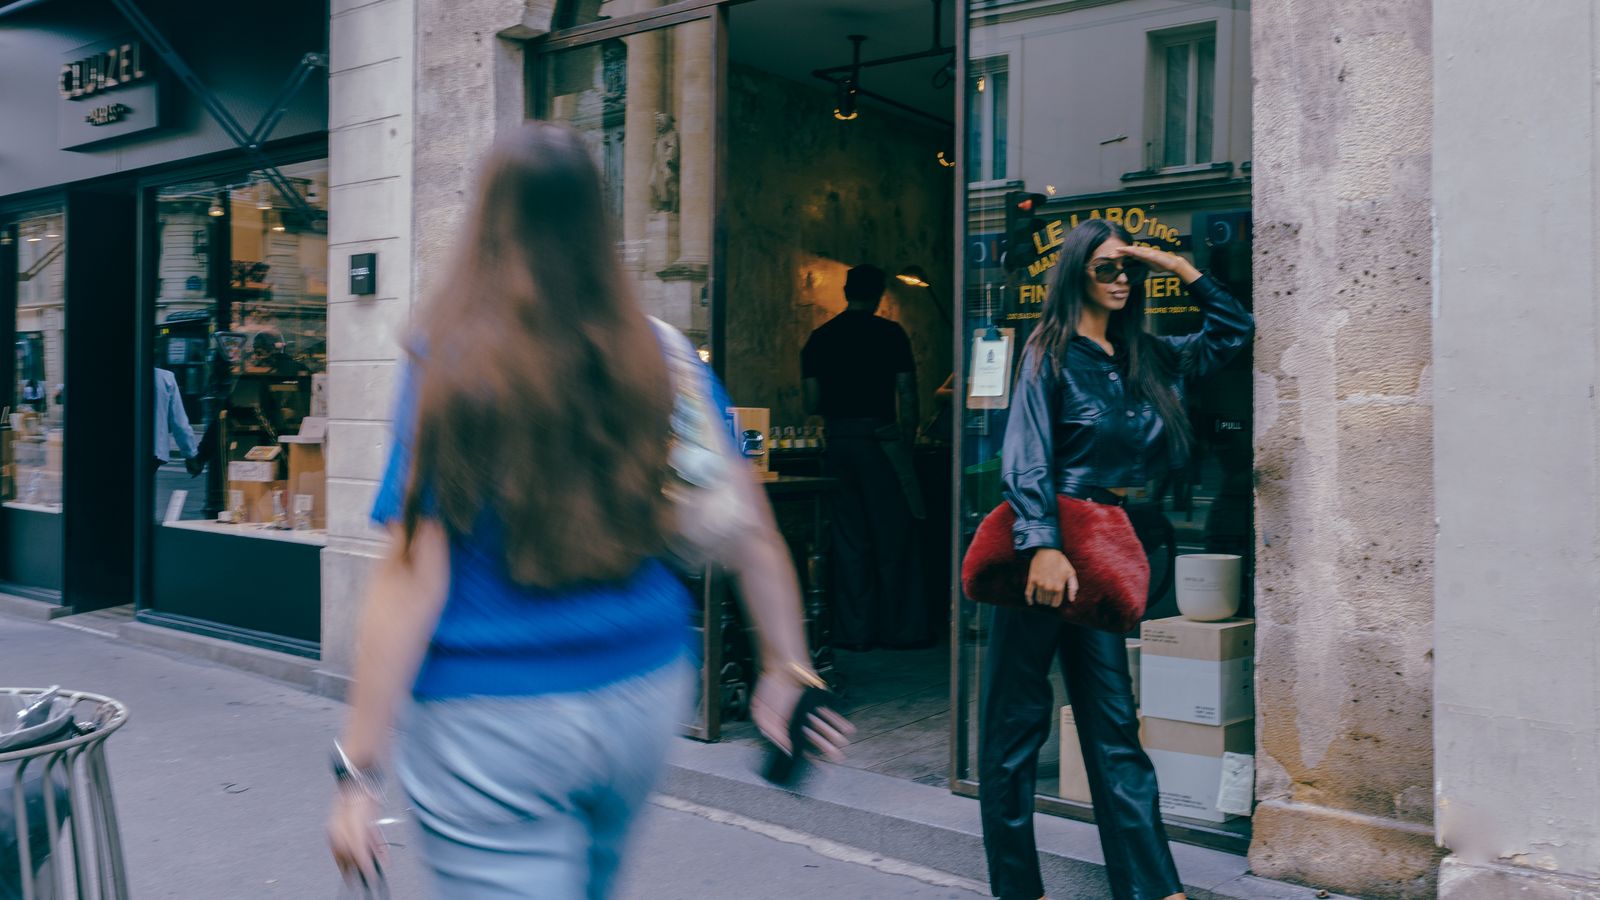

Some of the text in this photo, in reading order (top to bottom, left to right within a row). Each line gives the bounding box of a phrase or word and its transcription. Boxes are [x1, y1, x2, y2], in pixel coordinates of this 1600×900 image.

[1032, 219, 1065, 255] LE
[1028, 250, 1061, 278] MAN
[1019, 277, 1190, 304] FIN IER.
